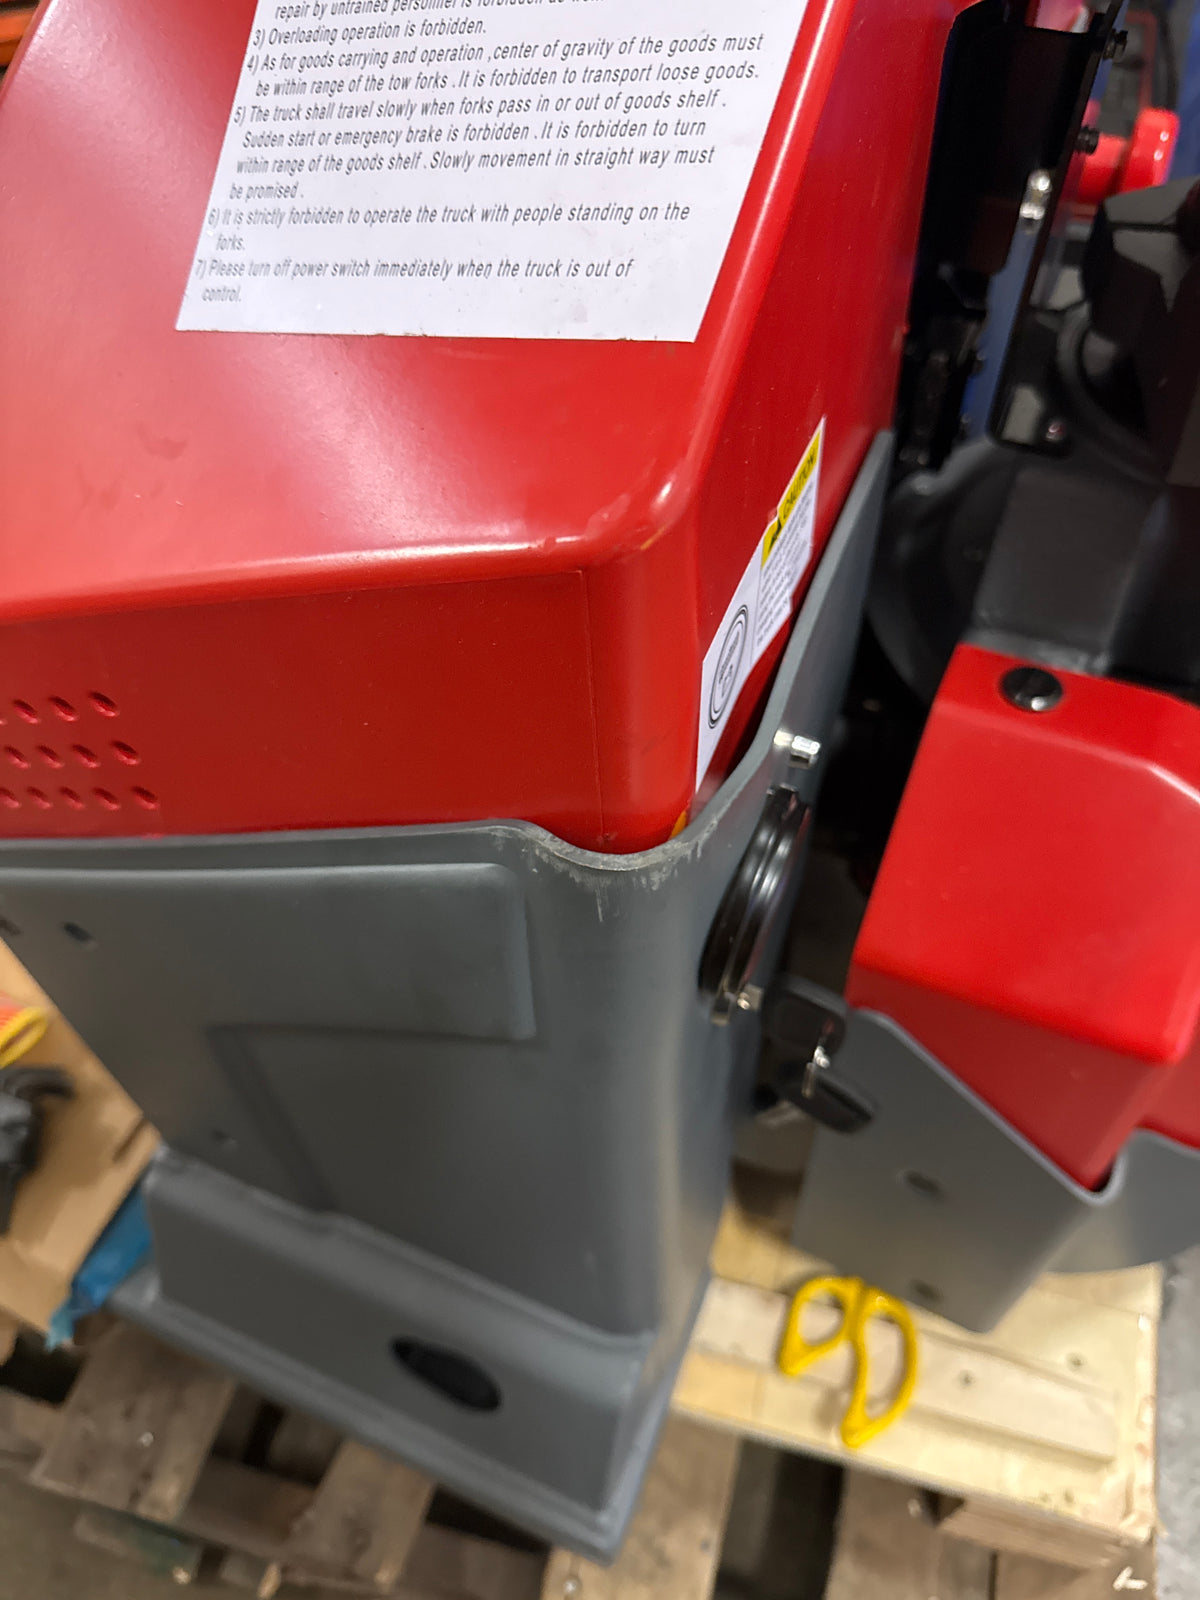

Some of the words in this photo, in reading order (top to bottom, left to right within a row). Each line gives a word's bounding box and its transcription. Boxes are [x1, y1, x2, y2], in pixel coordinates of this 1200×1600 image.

[275, 1, 311, 22] repair
[312, 0, 328, 20] by
[330, 0, 388, 16] untrained
[252, 28, 266, 49] 3)
[267, 24, 338, 46] Overloading
[340, 21, 400, 45] operation
[403, 20, 416, 37] is
[418, 16, 486, 37] forbidden.
[246, 54, 259, 74] 4)
[260, 53, 277, 71] As
[278, 51, 297, 70] for
[297, 49, 335, 72] goods
[337, 47, 389, 69] carrying
[391, 45, 418, 64] and
[541, 40, 560, 58] of
[559, 38, 614, 62] gravity
[617, 37, 636, 55] of
[637, 37, 663, 54] the
[666, 35, 717, 58] goods
[721, 33, 764, 51] must
[254, 79, 270, 97] be
[272, 77, 307, 95] within
[309, 79, 345, 97] range
[347, 73, 364, 93] of
[363, 73, 385, 92] the
[387, 73, 412, 91] tow
[472, 69, 486, 87] is
[561, 66, 577, 84] to
[581, 63, 653, 86] transport
[655, 63, 700, 84] loose
[702, 61, 758, 84] goods.
[233, 105, 246, 126] 5)
[249, 104, 270, 122] The
[272, 103, 302, 122] truck
[304, 101, 336, 120] shall
[336, 100, 375, 119] travel
[375, 99, 418, 121] slowly
[420, 98, 455, 116] when
[458, 96, 494, 115] forks
[495, 98, 532, 118] pass
[535, 94, 550, 112] in
[554, 96, 572, 112] or
[574, 93, 600, 111] out
[603, 92, 622, 110] of
[621, 91, 672, 114] goods
[241, 130, 285, 148] Sudden
[286, 129, 316, 147] start
[317, 131, 332, 146] or
[333, 129, 403, 148] emergency
[404, 124, 443, 143] brake
[445, 123, 459, 142] is
[555, 120, 570, 139] is
[652, 118, 668, 137] to
[673, 118, 706, 136] turn
[236, 156, 269, 173] within
[271, 158, 305, 176] range
[307, 154, 323, 172] of
[322, 153, 343, 172] the
[344, 152, 384, 175] goods
[477, 149, 552, 168] movement
[554, 149, 570, 166] in
[573, 147, 634, 170] straight
[638, 149, 671, 169] way
[673, 146, 715, 164] must
[228, 182, 243, 200] be
[207, 208, 221, 229] 6)
[221, 209, 232, 225] It
[233, 209, 244, 225] is
[245, 207, 283, 228] strictly
[287, 206, 344, 225] forbidden
[346, 207, 360, 224] to
[362, 206, 412, 227] operate
[415, 205, 438, 223] the
[440, 204, 477, 223] truck
[480, 204, 509, 222] with
[511, 203, 563, 226] people
[566, 202, 634, 224] standing
[638, 205, 659, 221] on
[663, 202, 690, 220] the
[215, 232, 245, 251] forks.
[195, 259, 207, 280] 7)
[208, 260, 245, 277] Please
[247, 262, 271, 277] turn
[272, 259, 292, 276] off
[291, 262, 329, 280] power
[330, 259, 370, 277] switch
[372, 259, 453, 281] immediately
[456, 259, 493, 278] when
[496, 259, 520, 277] the
[523, 259, 563, 277] truck
[565, 259, 581, 277] is
[584, 259, 611, 277] out
[614, 259, 634, 277] of
[201, 285, 242, 302] control.
